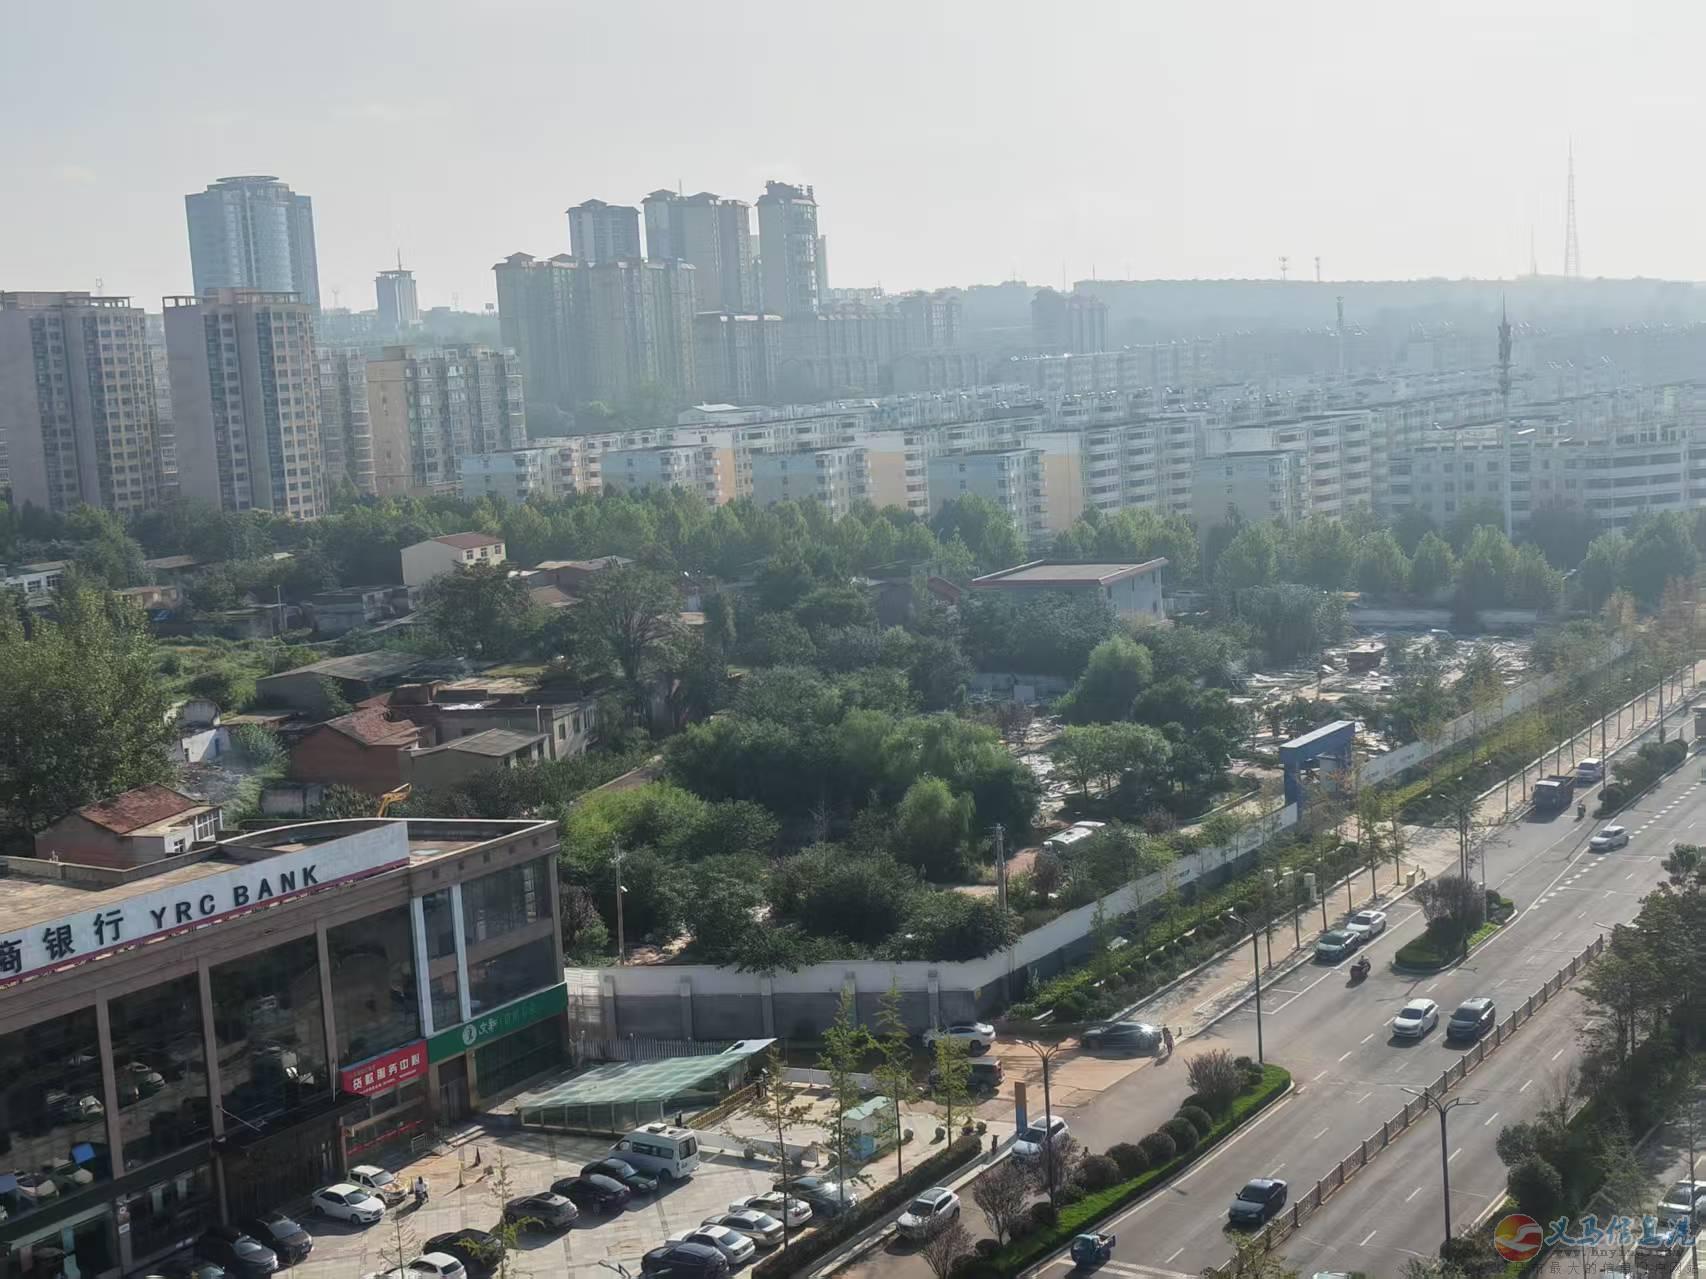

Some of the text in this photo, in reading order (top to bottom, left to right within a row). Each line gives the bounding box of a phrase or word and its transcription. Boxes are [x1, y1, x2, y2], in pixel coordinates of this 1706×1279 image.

[0, 865, 318, 974] 商银行 YRC BANK
